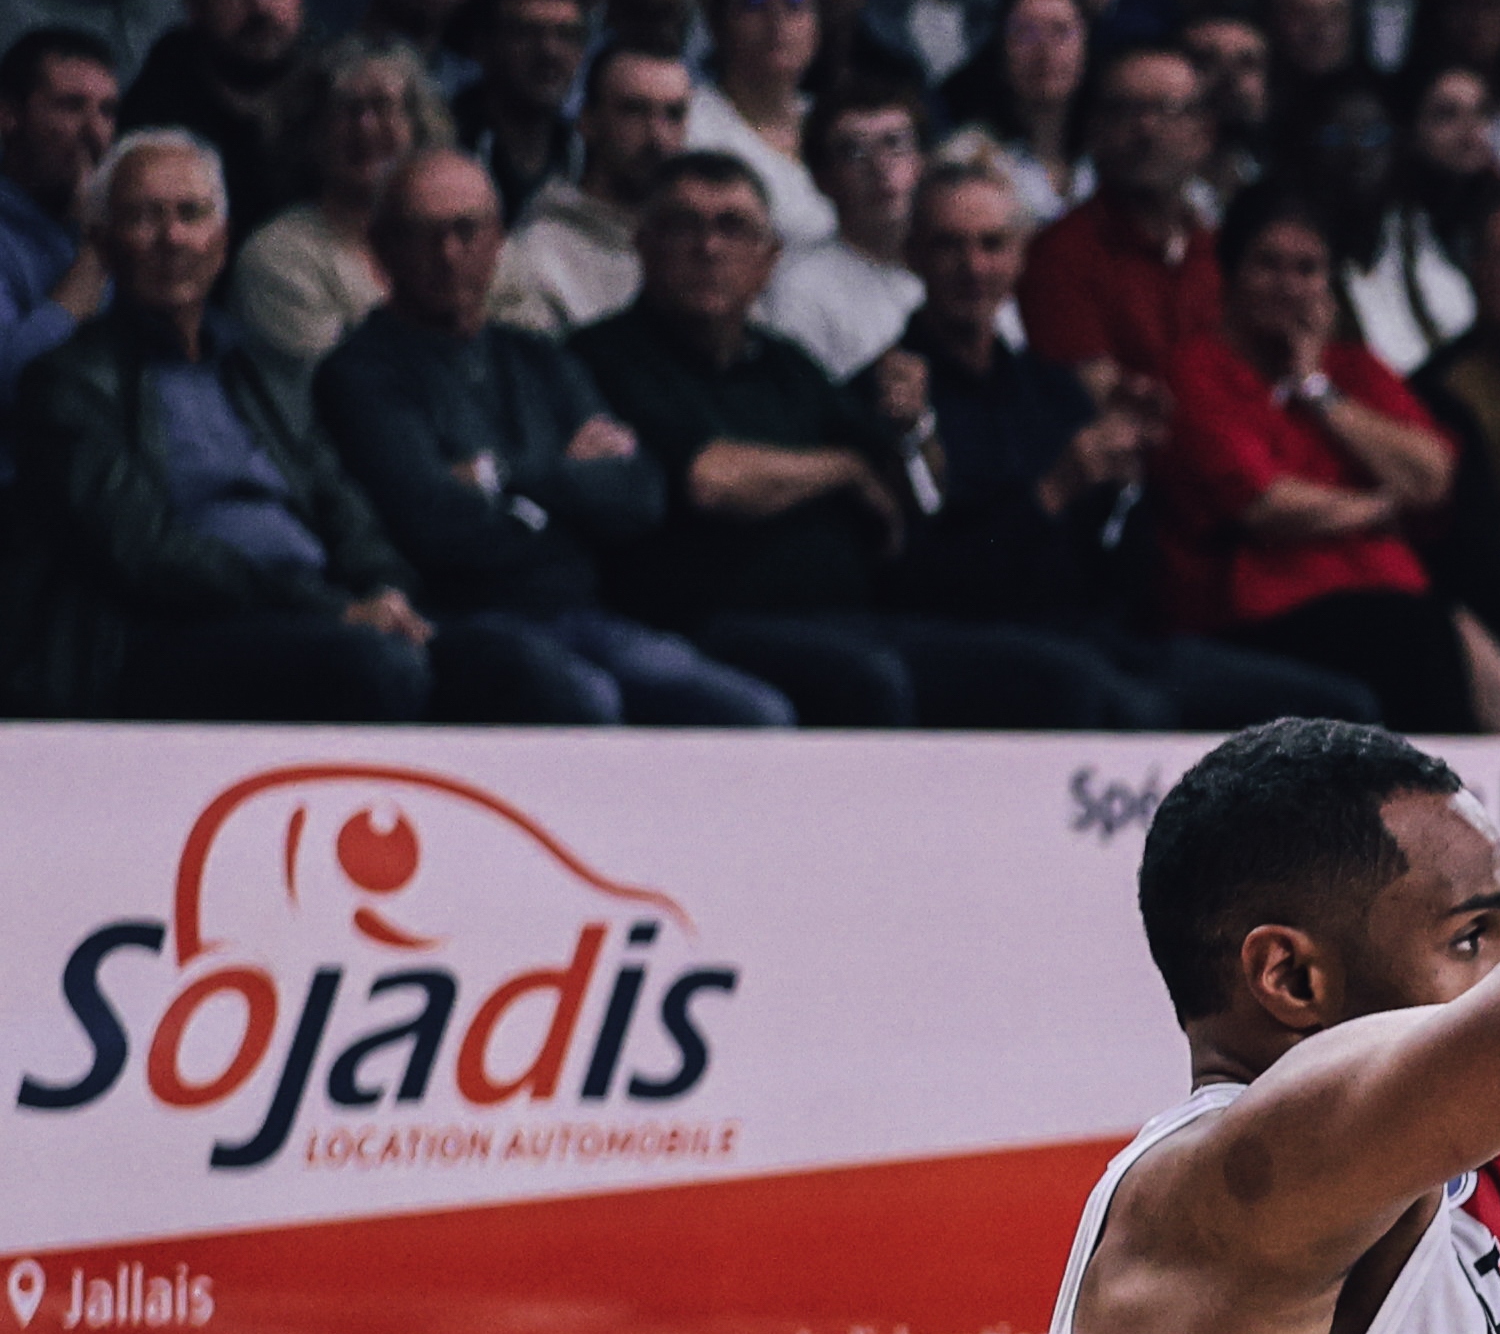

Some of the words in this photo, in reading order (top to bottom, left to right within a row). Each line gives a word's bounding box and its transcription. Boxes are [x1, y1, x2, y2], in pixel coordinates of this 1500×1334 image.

[17, 917, 739, 1171] Sojadis
[305, 1123, 493, 1166] LOCATION
[503, 1119, 743, 1161] AUTOMOBILE
[63, 1263, 214, 1329] Jallais
